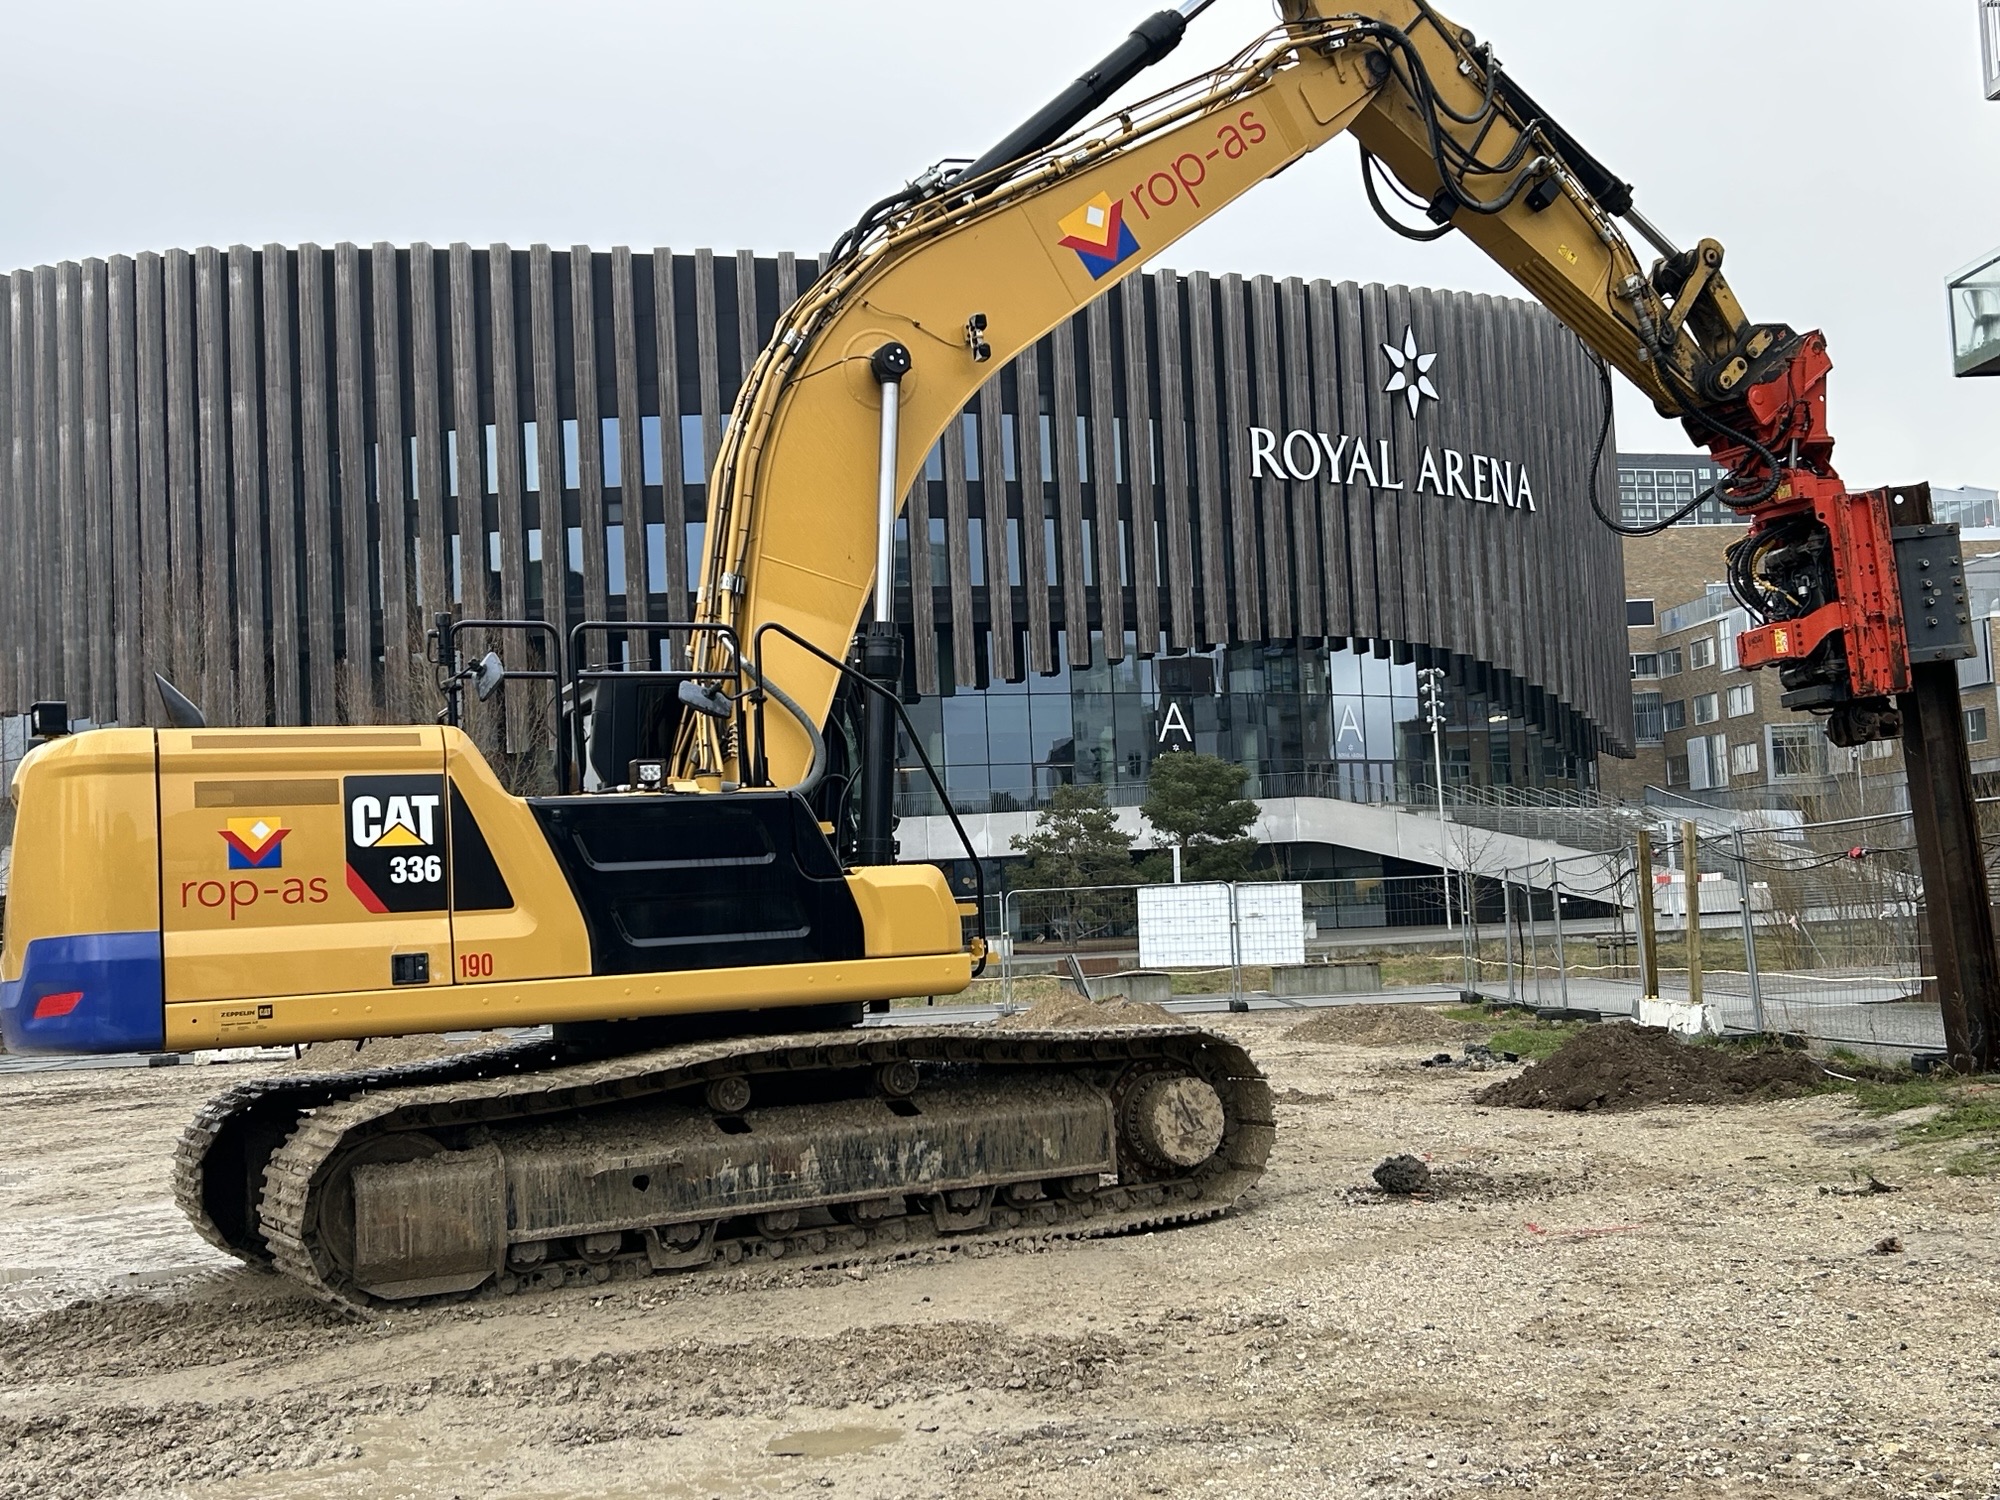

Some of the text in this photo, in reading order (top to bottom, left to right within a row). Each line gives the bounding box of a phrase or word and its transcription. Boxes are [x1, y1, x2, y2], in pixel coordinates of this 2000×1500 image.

[1130, 111, 1267, 220] rop-as
[1249, 427, 1537, 512] ROYAL ARENA
[1159, 702, 1192, 742] A
[1337, 704, 1364, 742] A
[352, 795, 440, 848] CAT
[390, 855, 442, 884] 336
[181, 877, 329, 921] rop-as
[459, 953, 494, 978] 190
[220, 1010, 255, 1018] ZEPPELIN
